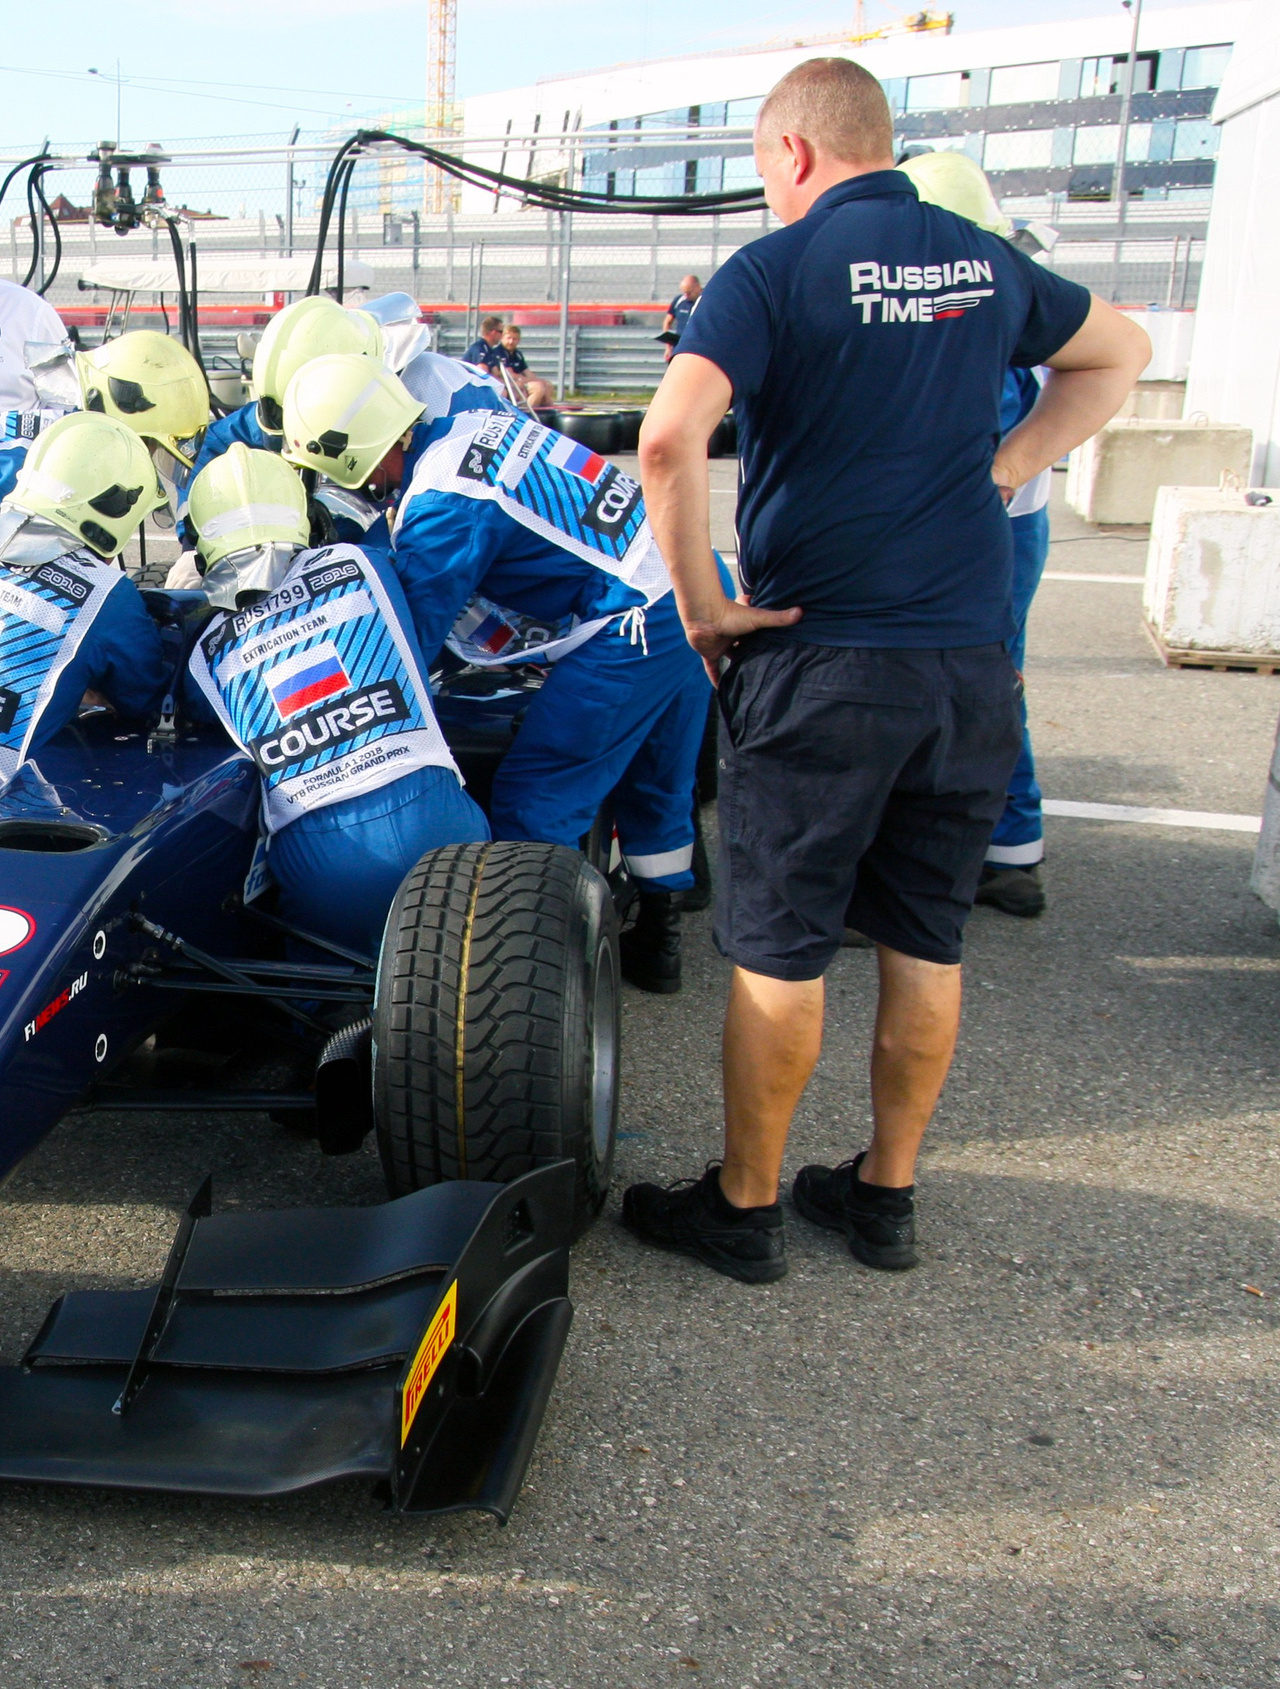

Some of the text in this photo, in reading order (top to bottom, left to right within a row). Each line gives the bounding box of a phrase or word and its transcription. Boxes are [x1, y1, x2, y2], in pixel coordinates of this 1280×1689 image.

[849, 259, 994, 293] RUSSIAN
[851, 293, 934, 325] TIME
[596, 470, 641, 524] COUR
[37, 565, 87, 599] 2018
[308, 563, 360, 592] 2018
[0, 588, 23, 608] TEAM
[242, 614, 328, 664] EXTRICATION TEAM
[259, 689, 397, 766] COURSE
[286, 789, 306, 805] VTB
[307, 771, 349, 793] RUSSIAN
[350, 755, 386, 776] GRAND
[387, 745, 411, 761] PRIX
[303, 761, 351, 785] FORMULA
[359, 746, 384, 762] 2018
[405, 1303, 451, 1428] PIRELLI
